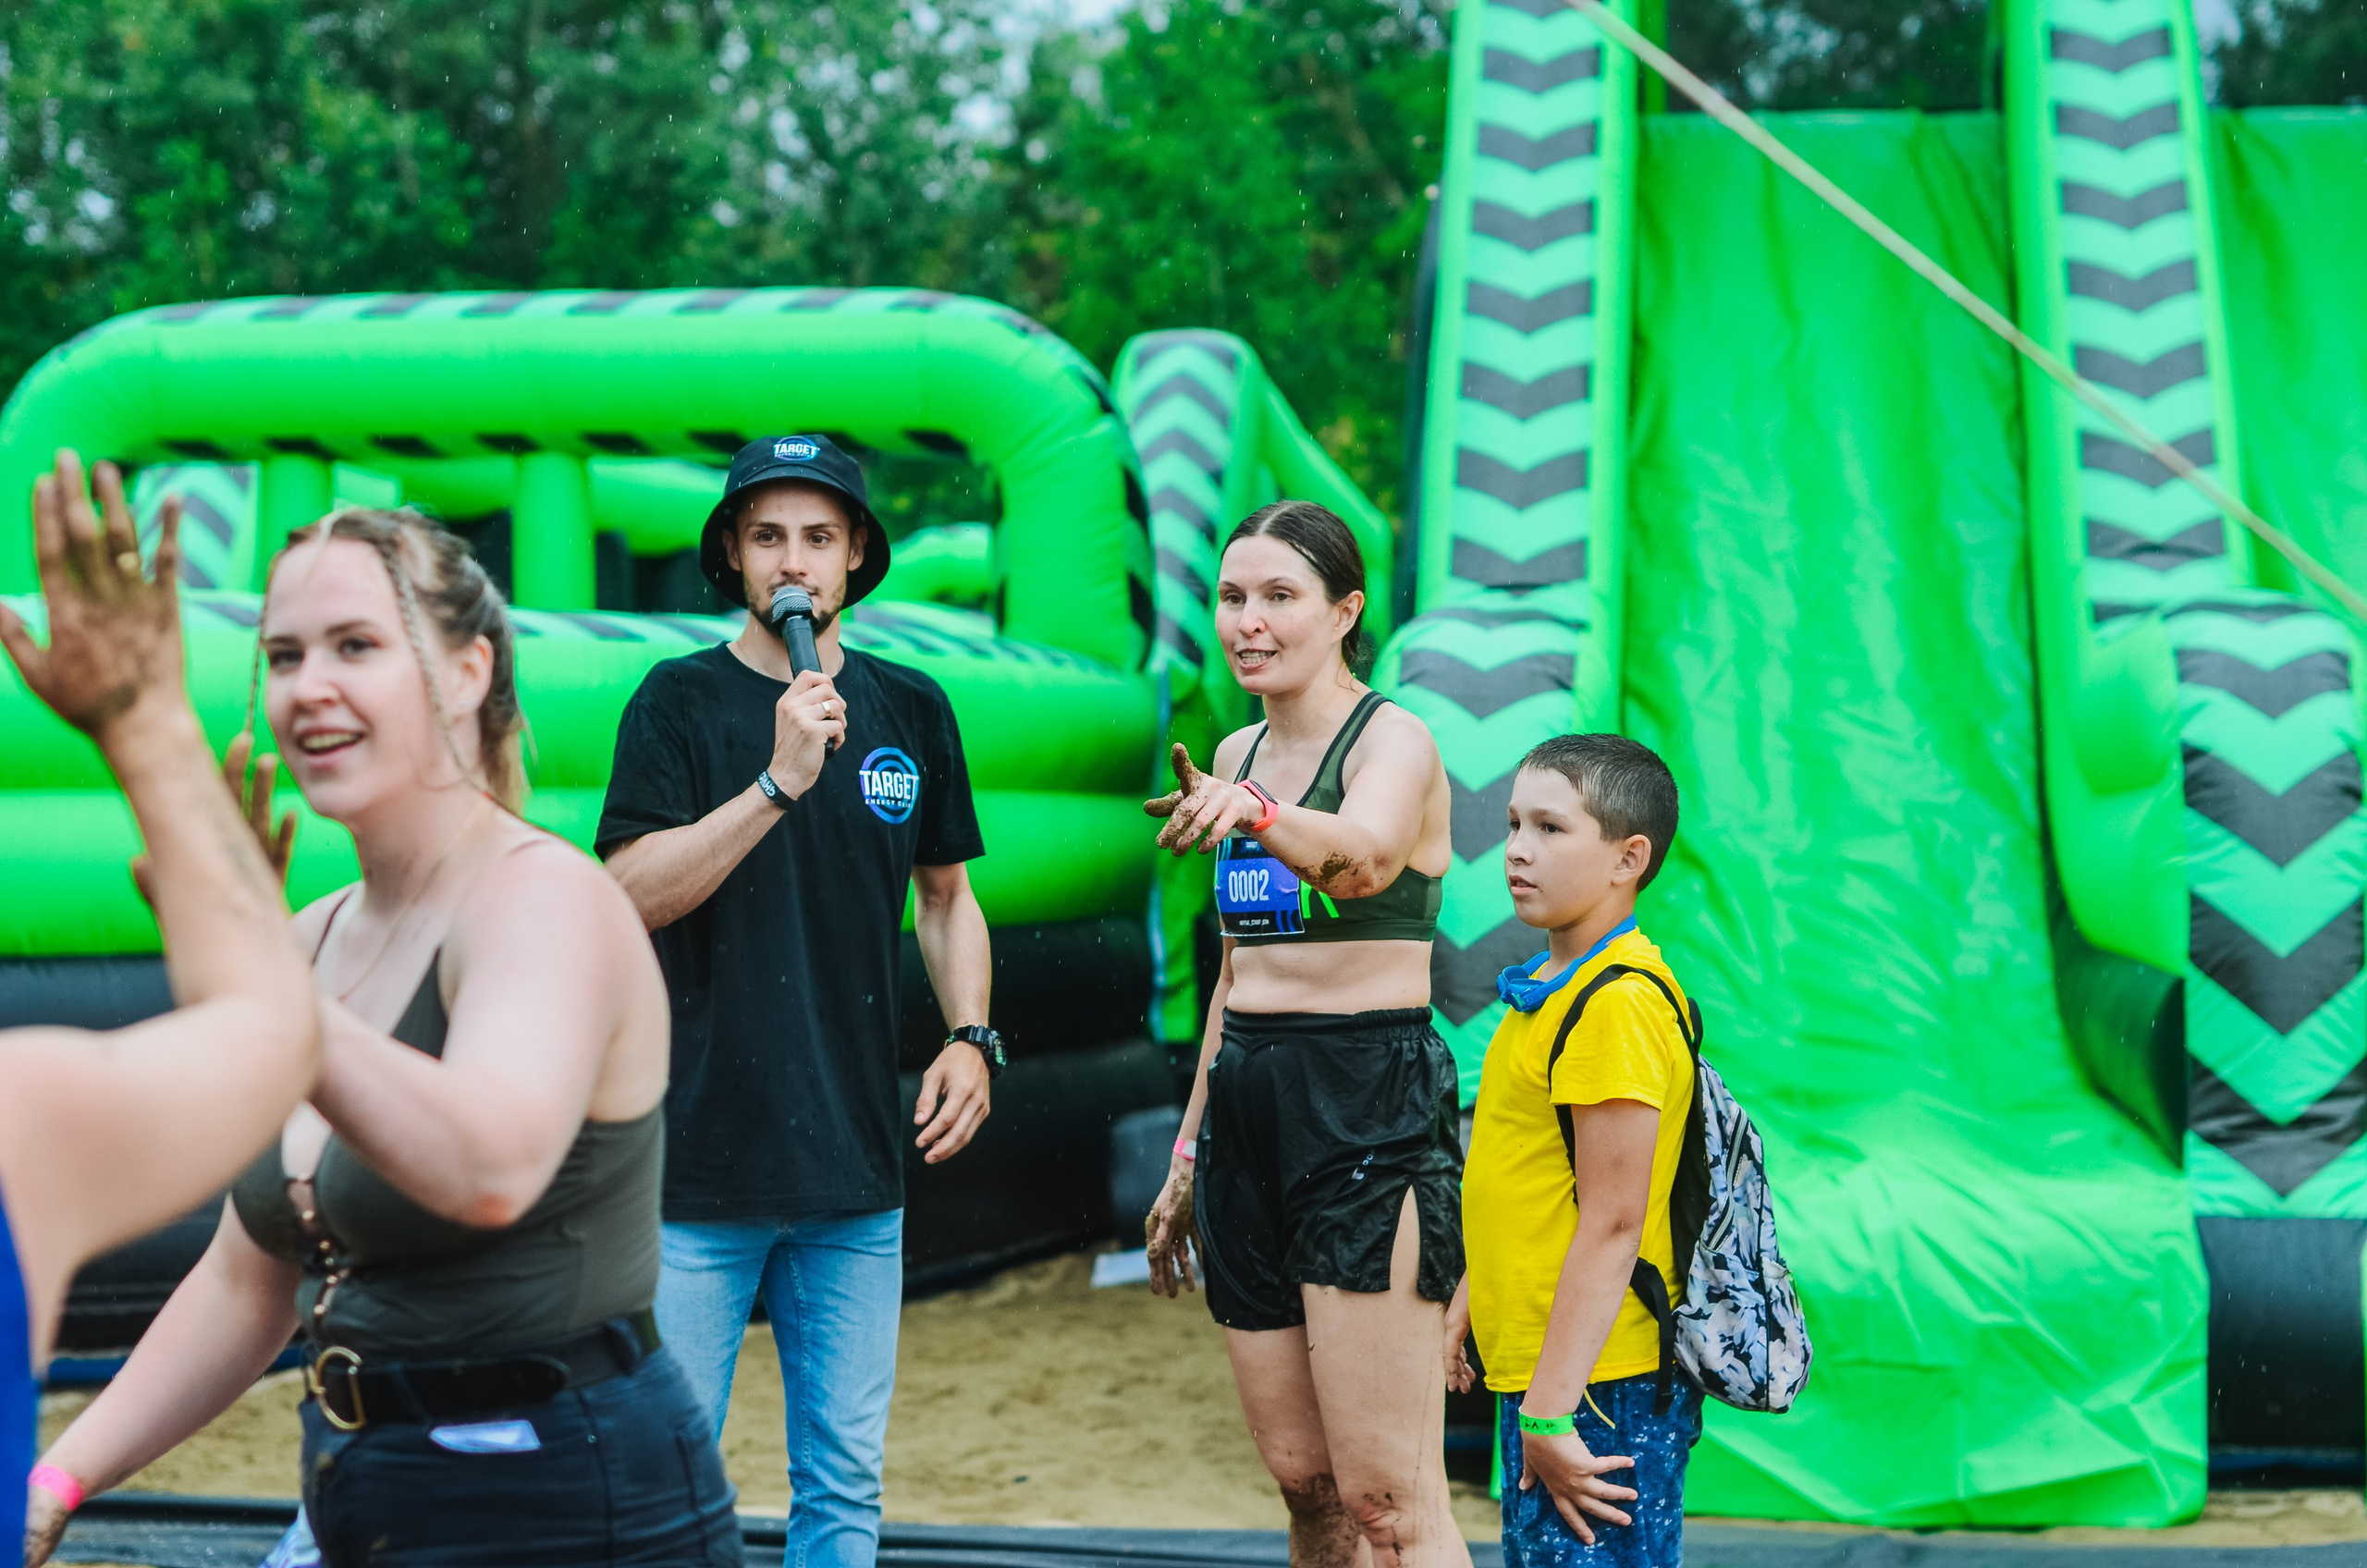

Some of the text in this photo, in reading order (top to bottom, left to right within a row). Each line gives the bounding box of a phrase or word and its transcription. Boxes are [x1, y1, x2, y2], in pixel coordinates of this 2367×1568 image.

[773, 443, 817, 455] TARGET
[859, 769, 920, 801] TARGET
[1228, 869, 1269, 902] 0002
